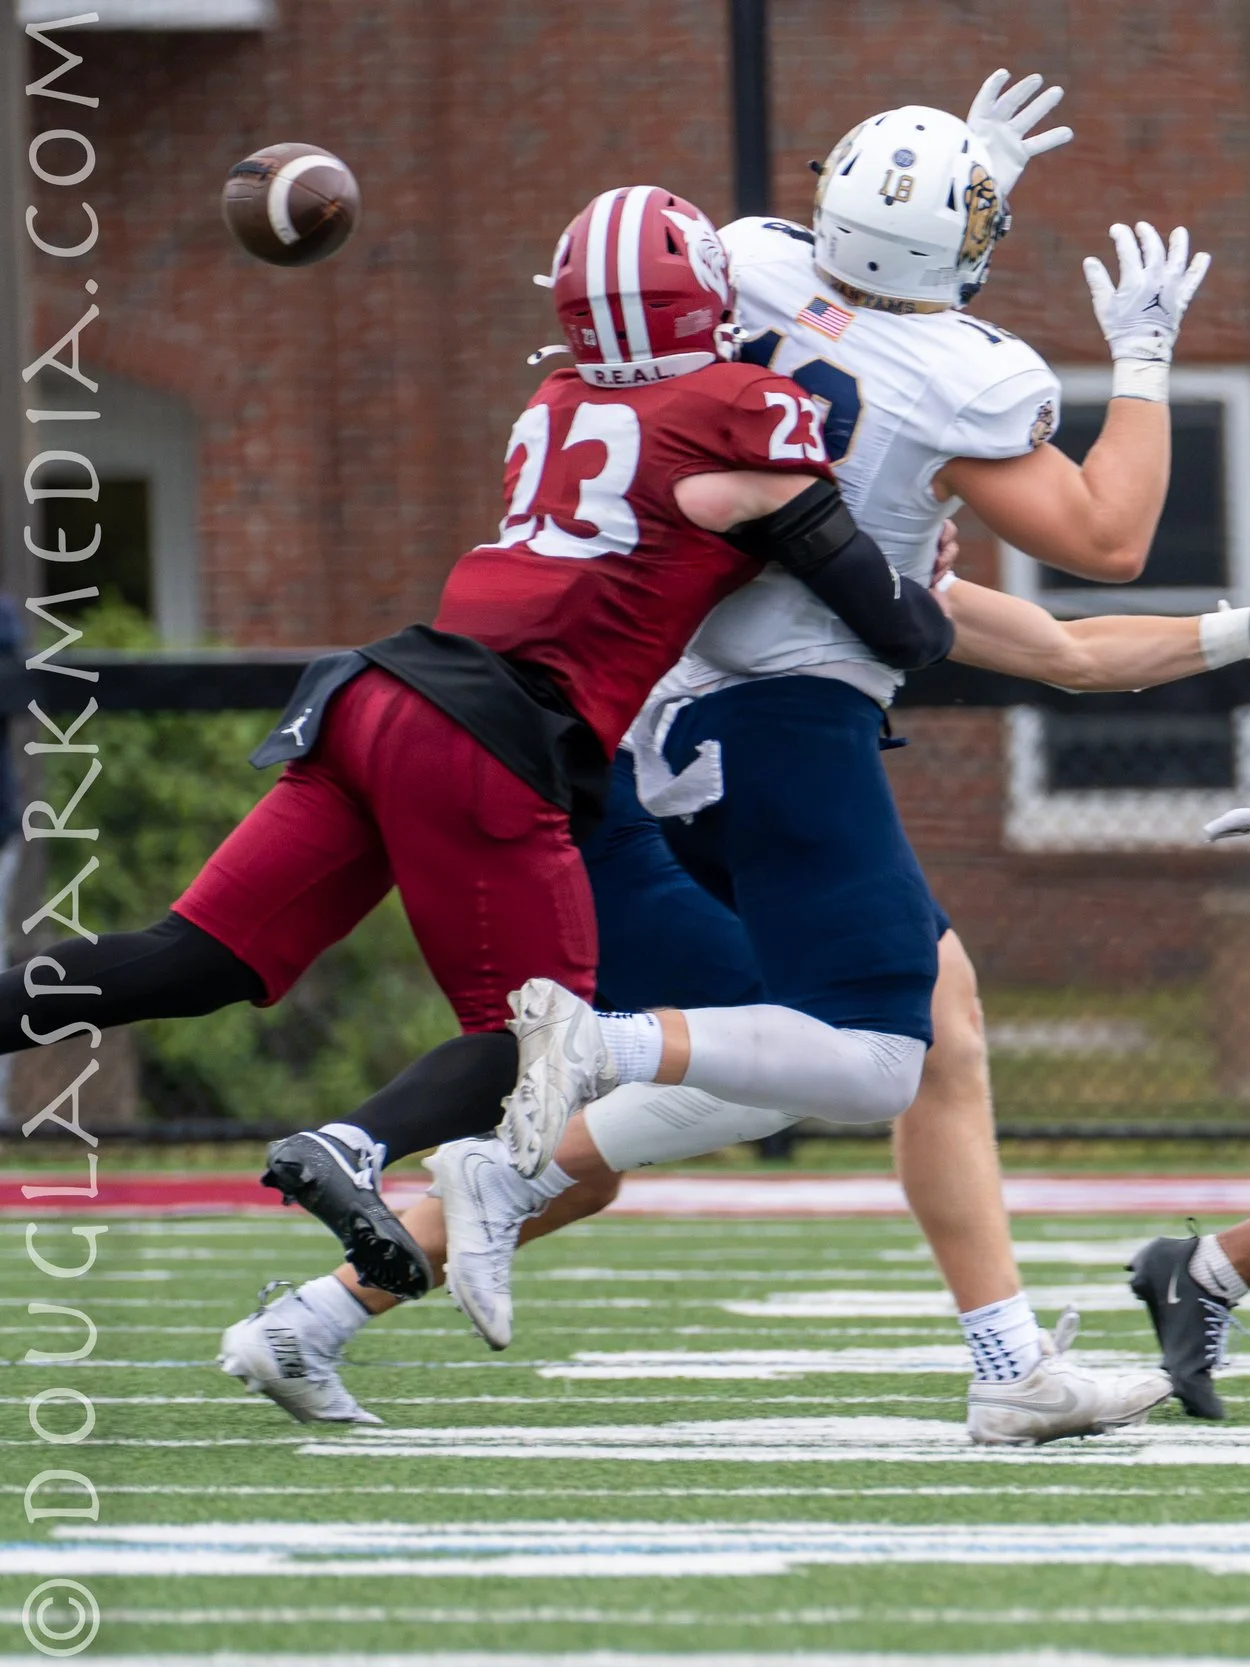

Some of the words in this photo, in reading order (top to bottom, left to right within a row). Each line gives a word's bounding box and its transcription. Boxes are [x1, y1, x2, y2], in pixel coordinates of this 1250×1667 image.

[878, 169, 914, 203] 18
[764, 391, 826, 462] 23
[472, 402, 641, 559] 23
